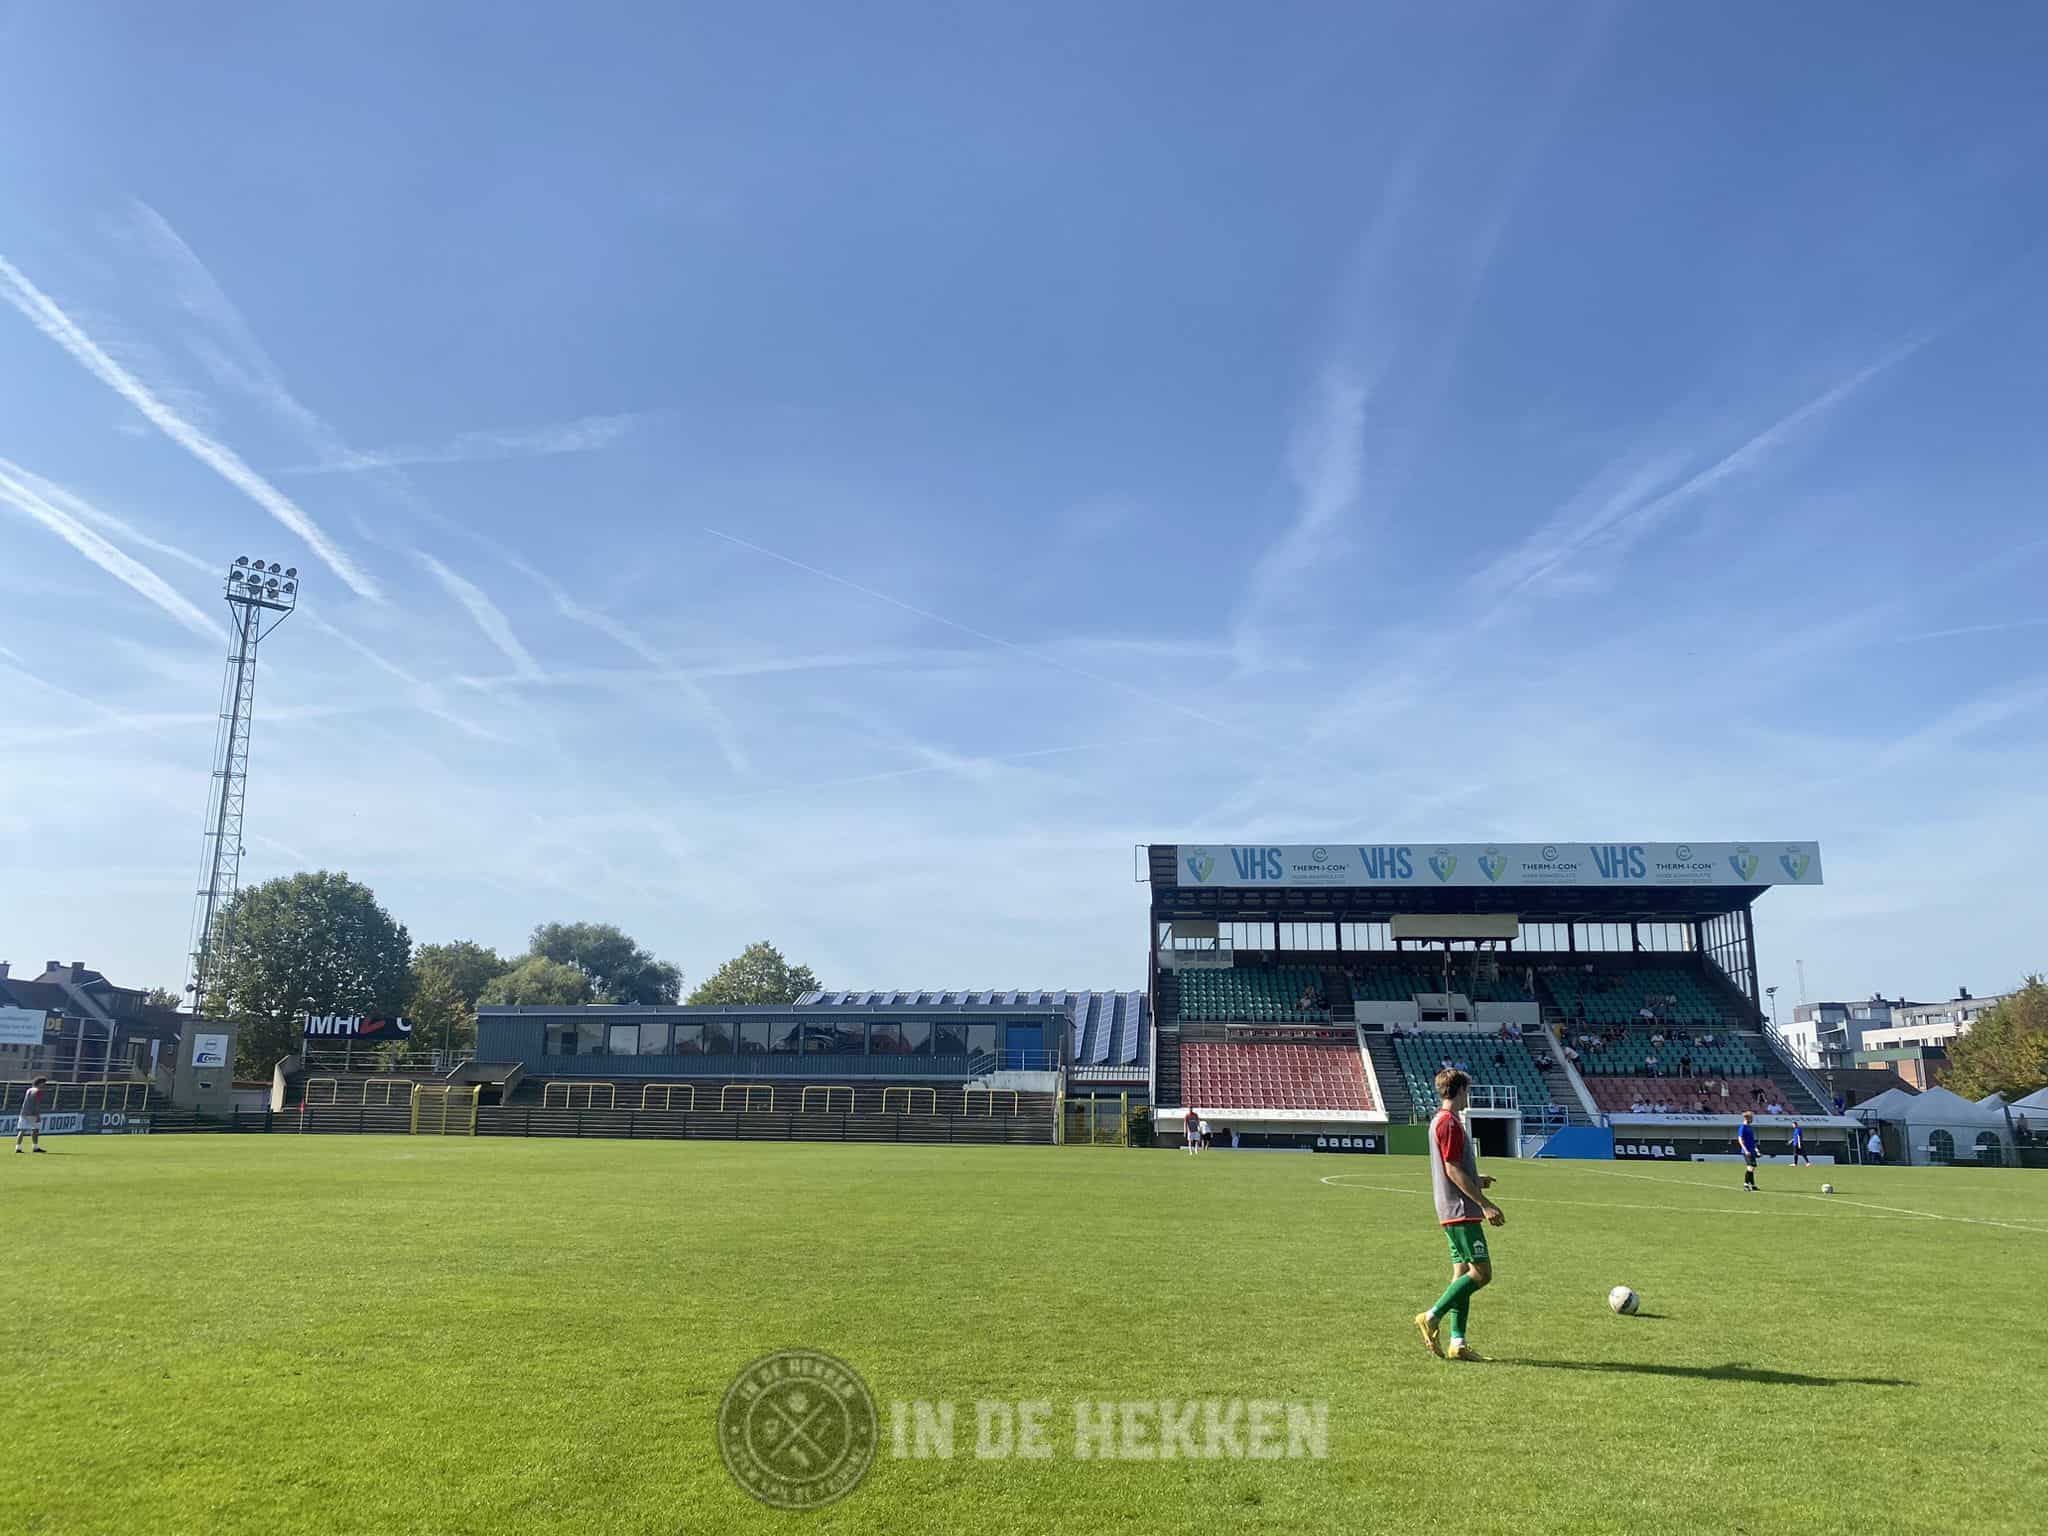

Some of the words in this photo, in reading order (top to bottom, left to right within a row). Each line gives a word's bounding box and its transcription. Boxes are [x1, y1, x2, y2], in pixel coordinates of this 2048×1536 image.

[1231, 847, 1283, 880] VHS
[1359, 847, 1414, 880] VHS
[1590, 845, 1647, 879] VHS
